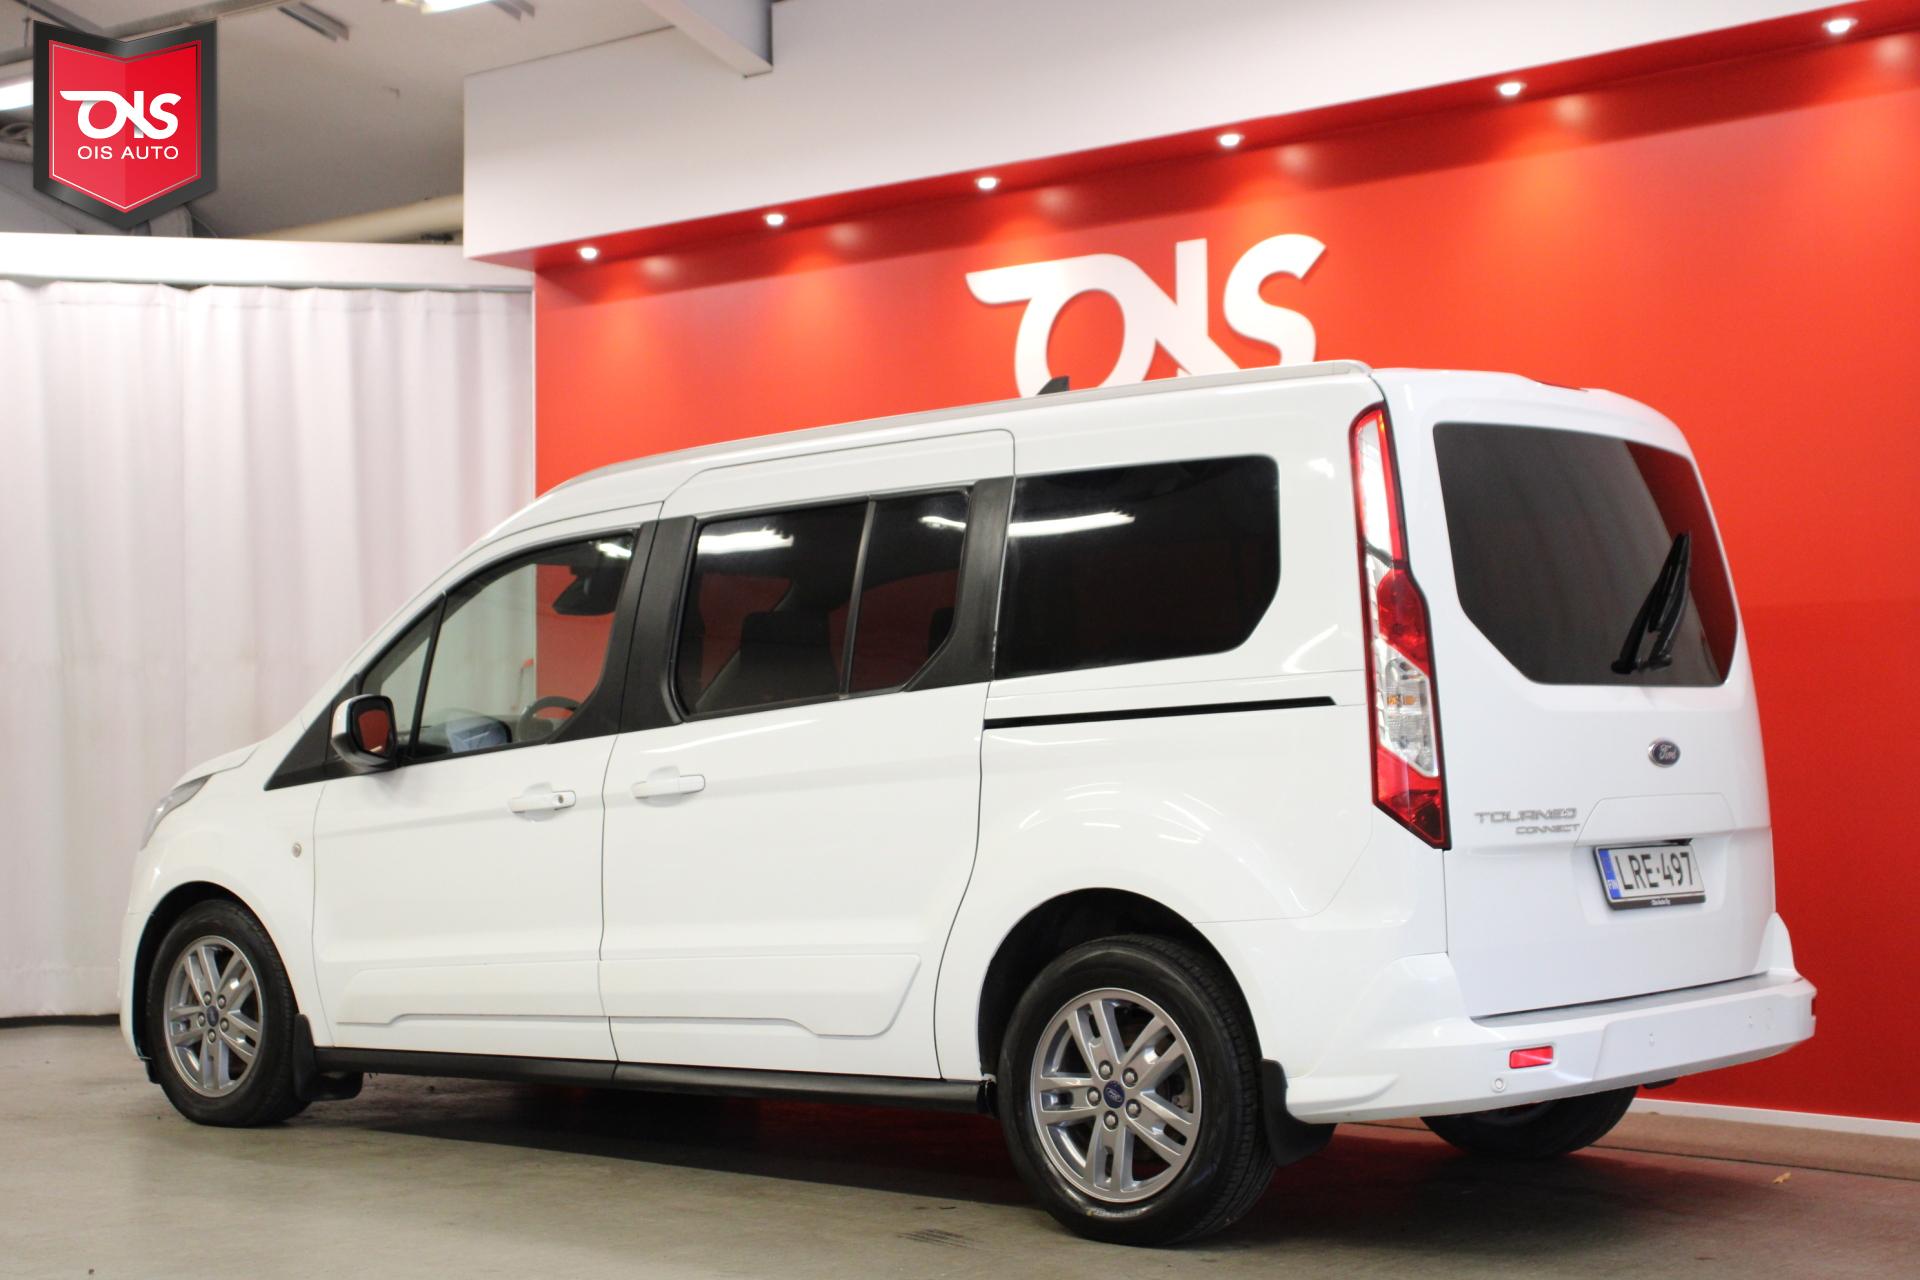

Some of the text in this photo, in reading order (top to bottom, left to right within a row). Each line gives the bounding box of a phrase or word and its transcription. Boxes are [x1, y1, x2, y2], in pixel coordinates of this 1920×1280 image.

[965, 233, 1327, 399] OIS
[1474, 807, 1578, 824] TOURNEO
[1515, 823, 1581, 835] CONNECT
[1614, 851, 1694, 890] LRE-497
